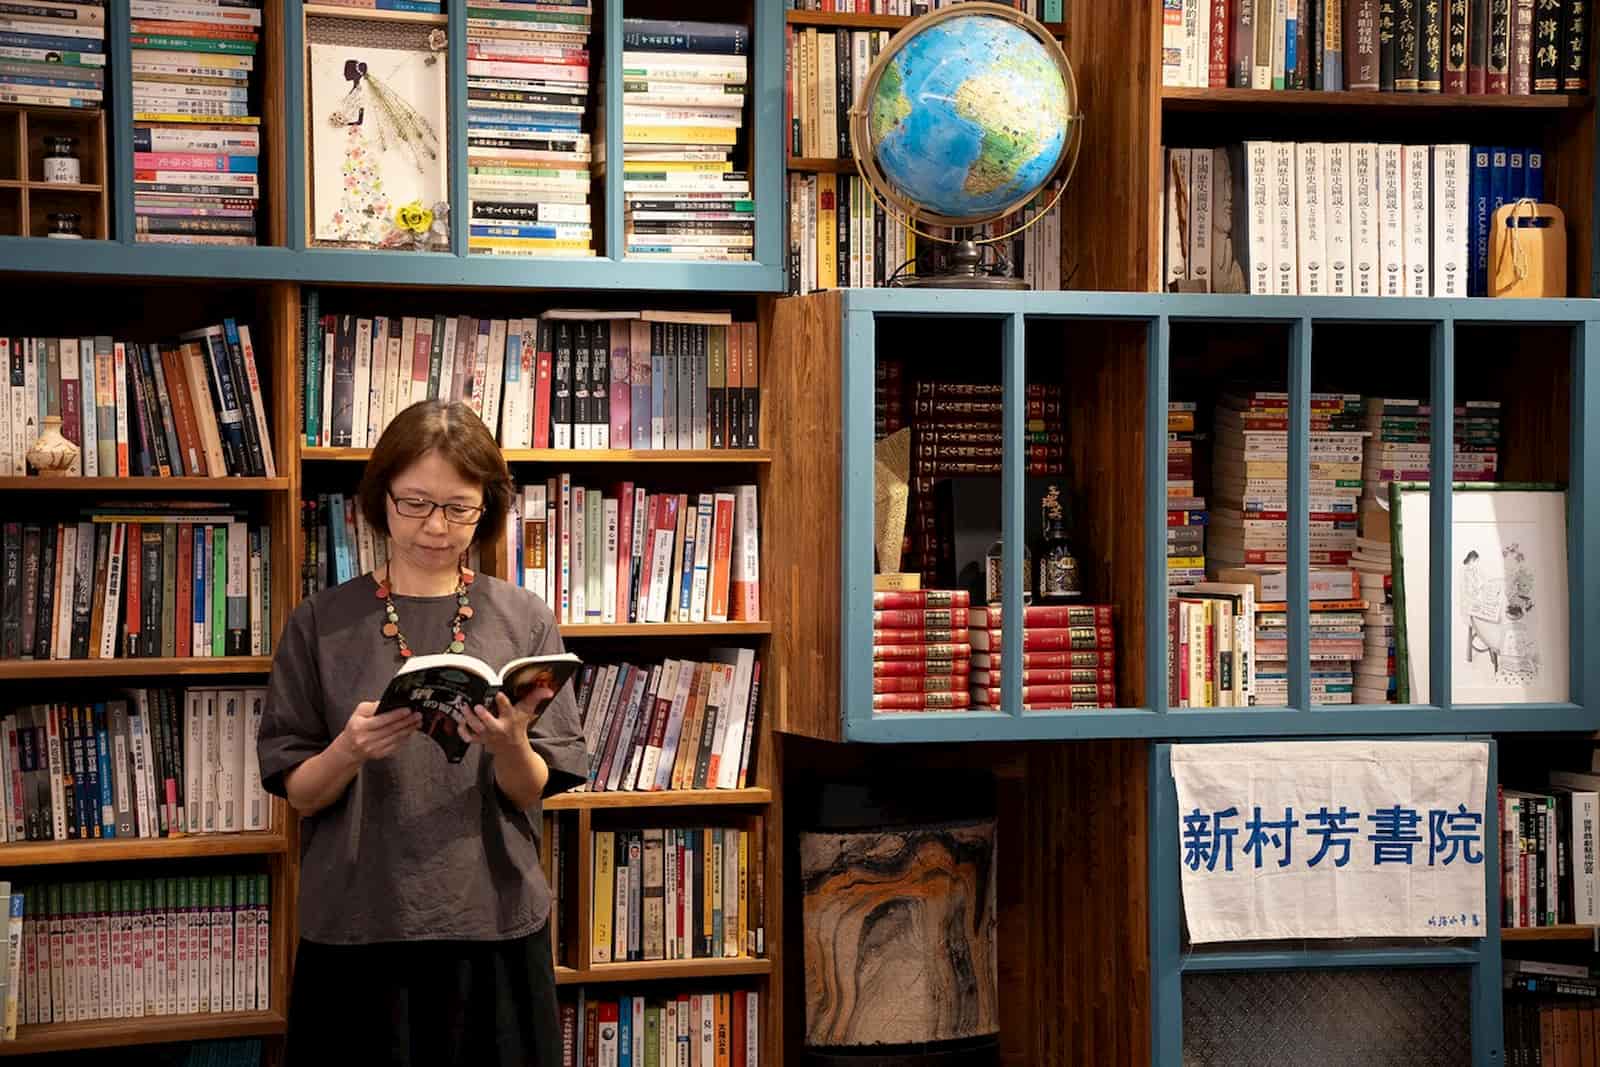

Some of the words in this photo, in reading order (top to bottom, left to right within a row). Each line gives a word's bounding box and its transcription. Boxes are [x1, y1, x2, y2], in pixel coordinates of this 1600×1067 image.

[1478, 153, 1487, 166] 3
[1495, 153, 1504, 166] 4
[1512, 154, 1521, 167] 5
[1530, 154, 1539, 167] 6
[1182, 804, 1484, 872] 新村芳書院
